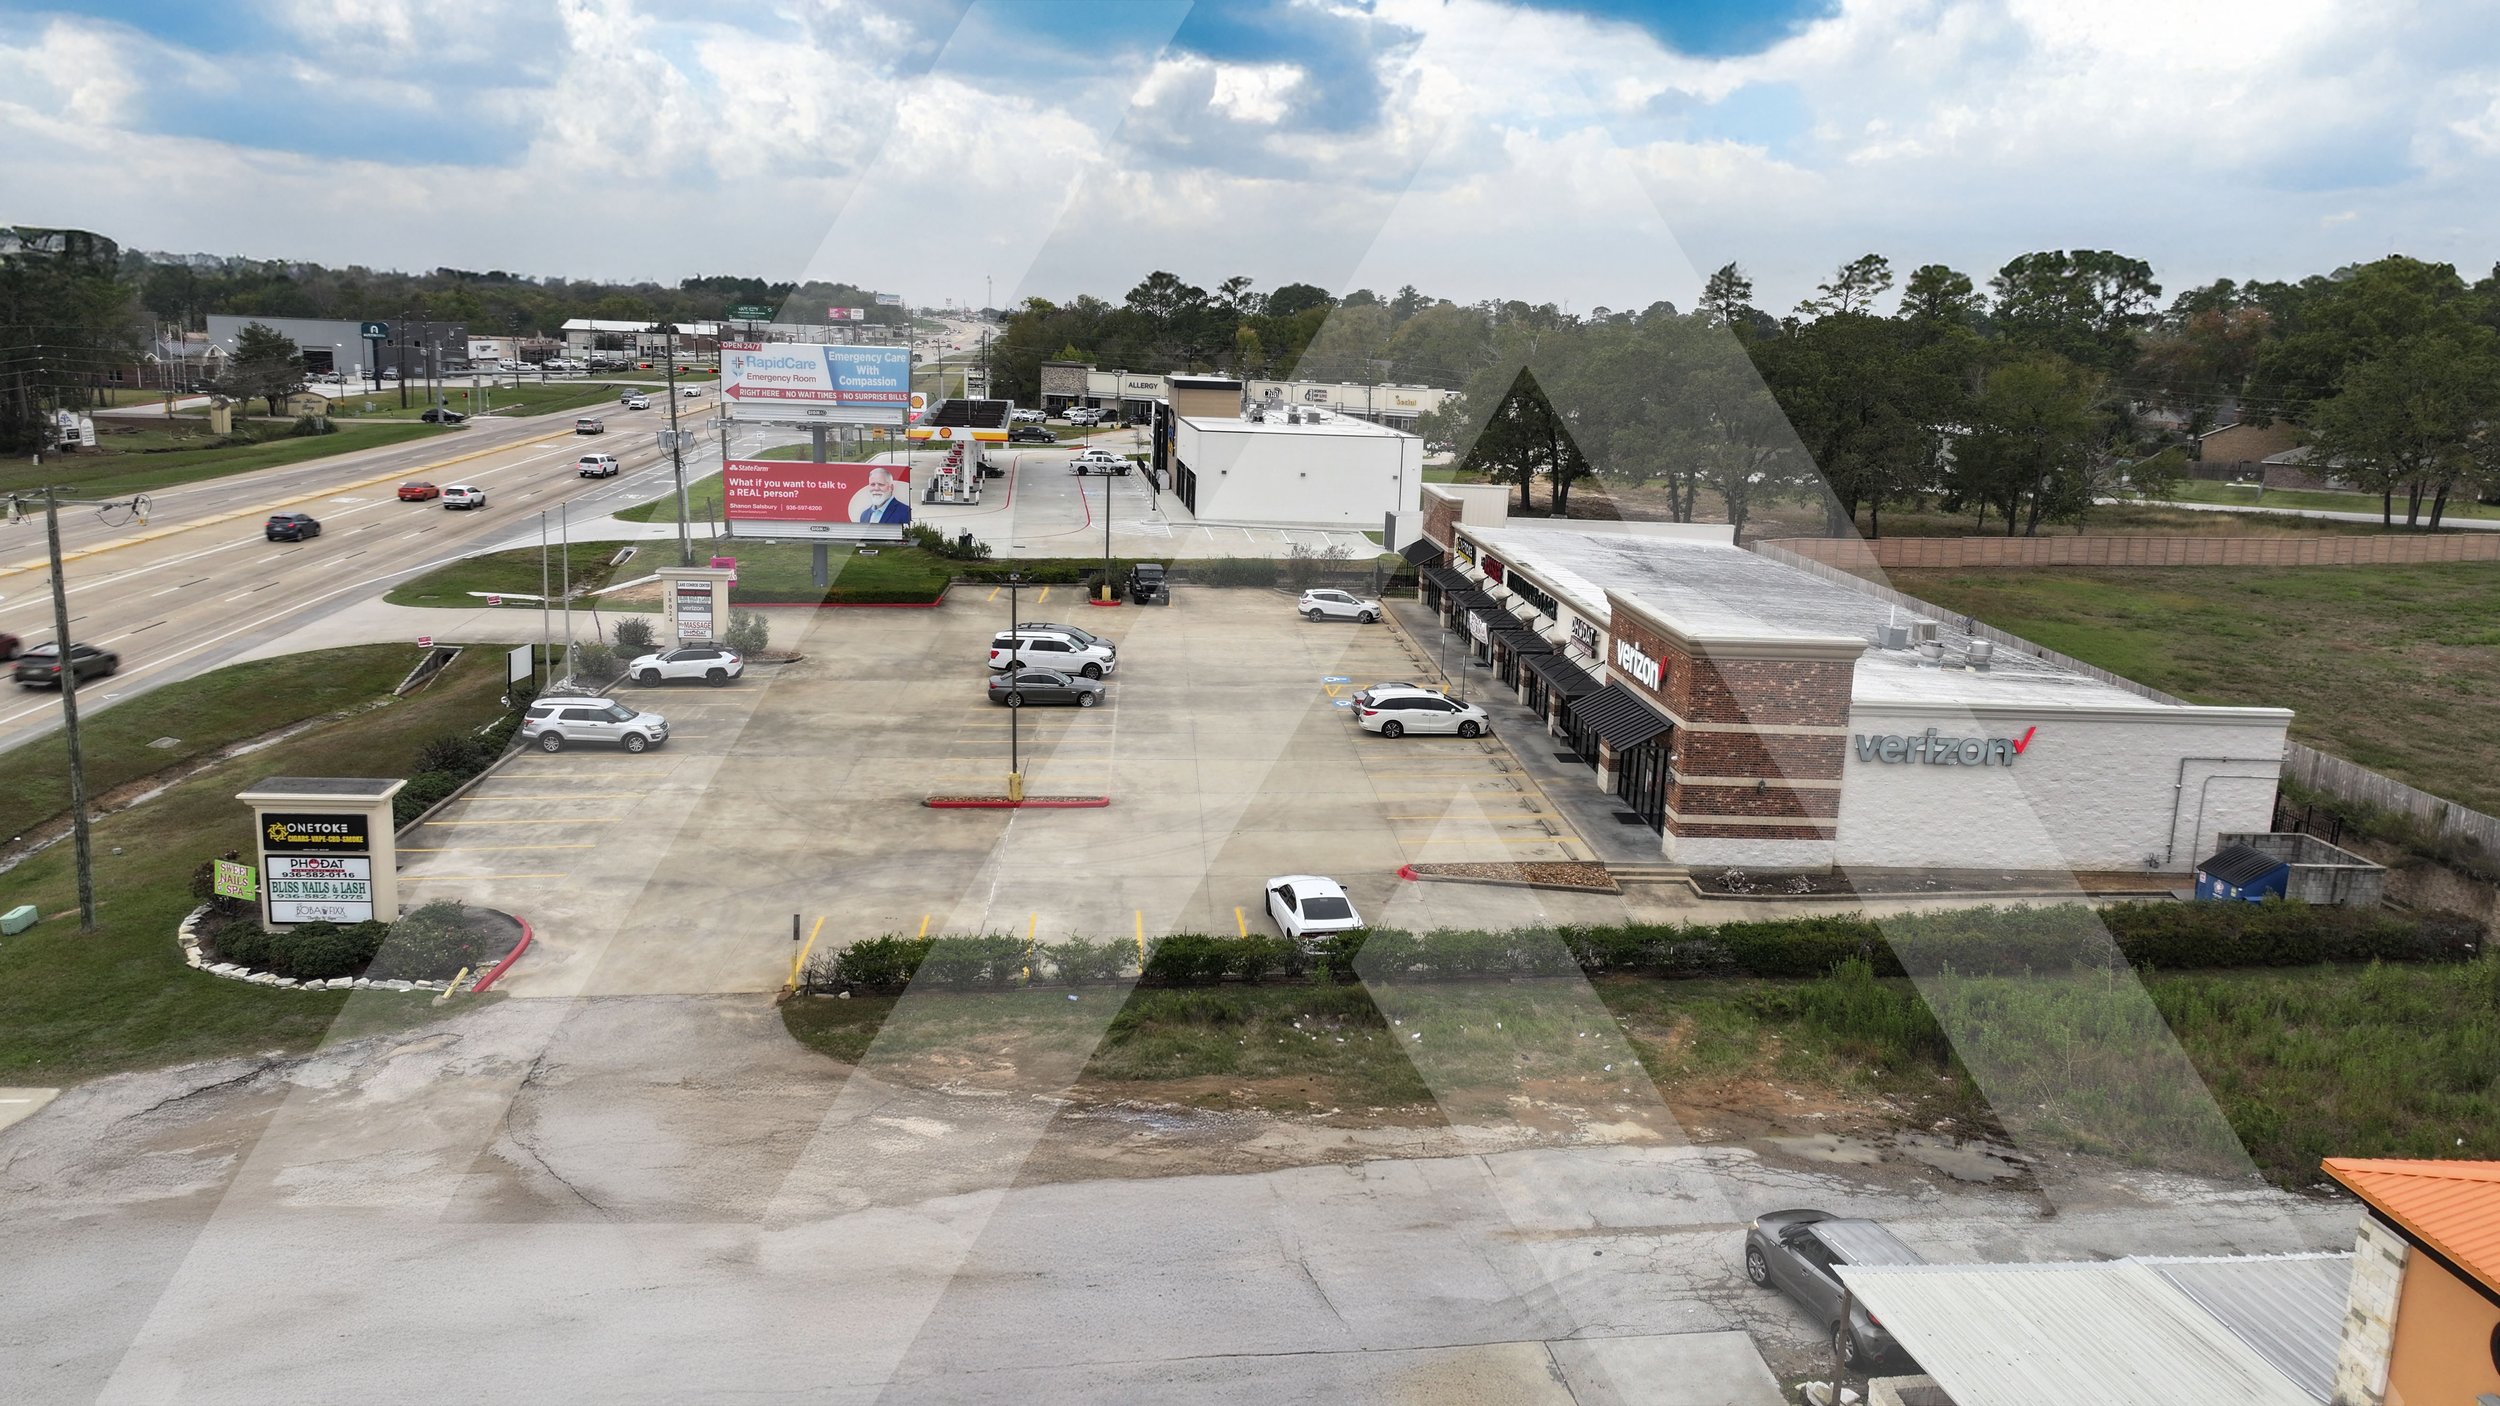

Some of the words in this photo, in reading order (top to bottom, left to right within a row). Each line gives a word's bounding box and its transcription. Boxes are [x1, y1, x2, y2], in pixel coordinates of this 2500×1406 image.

[828, 351, 882, 363] Emergency
[884, 353, 906, 362] Care
[746, 356, 816, 370] RapidCare
[856, 365, 879, 375] With
[747, 373, 791, 383] Emergency
[839, 376, 897, 387] Compassion
[888, 393, 908, 401] BILLS
[729, 478, 753, 486] What
[756, 478, 762, 486] if
[783, 480, 804, 488] want
[807, 480, 816, 488] to
[818, 481, 835, 489] talk
[763, 490, 799, 498] person?
[1617, 638, 1660, 692] verizon
[1855, 727, 2014, 767] verizon
[287, 823, 348, 833] ONETOKE
[220, 873, 249, 886] NAILS
[226, 885, 244, 897] SPA
[272, 881, 299, 893] BLISS
[302, 882, 330, 893] NAILS
[332, 884, 339, 893] &
[340, 882, 366, 894] LASH
